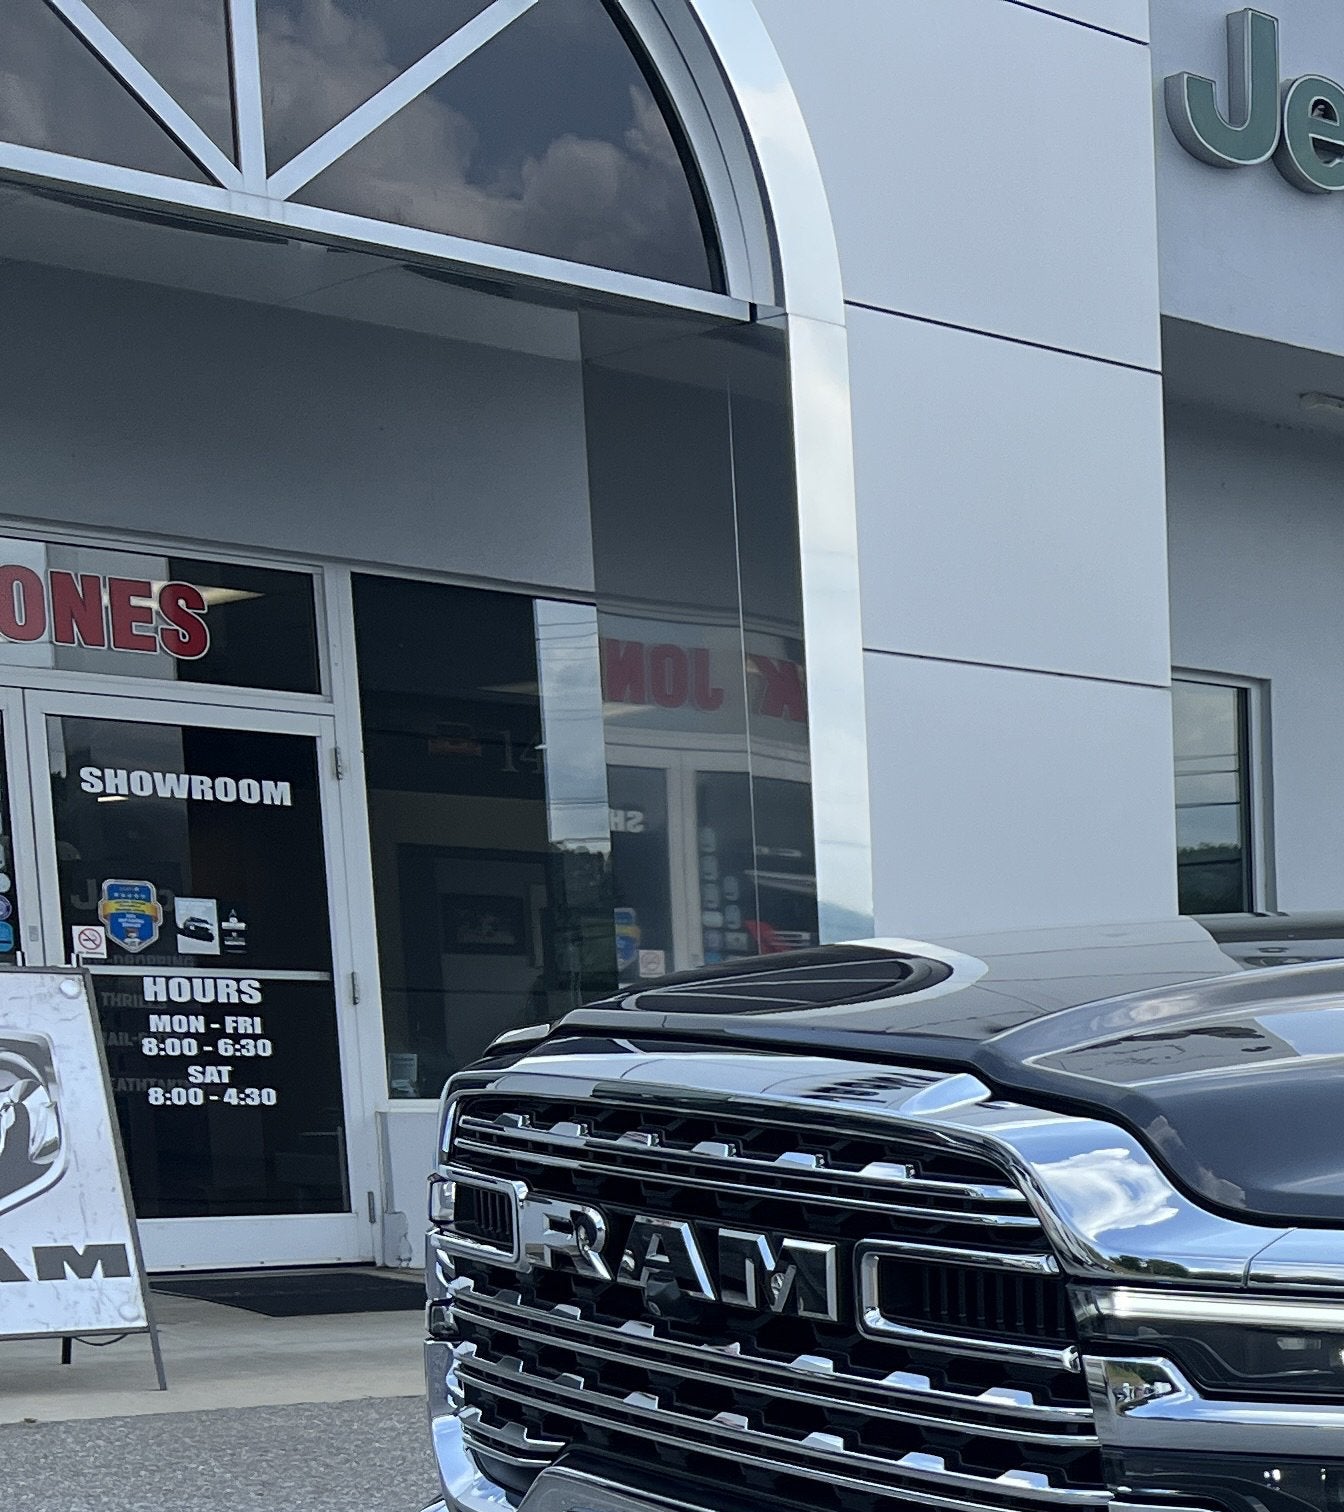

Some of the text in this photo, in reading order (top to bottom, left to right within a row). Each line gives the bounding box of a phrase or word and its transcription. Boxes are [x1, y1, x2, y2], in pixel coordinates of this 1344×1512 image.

[0, 564, 210, 660] ONES
[79, 766, 292, 806] SHOWROOM
[143, 976, 262, 1004] HOURS
[149, 1015, 205, 1034] MON
[225, 1016, 262, 1035] FRI
[142, 1037, 199, 1057] 8:00
[217, 1038, 273, 1057] 6:30
[188, 1065, 234, 1084] SAT
[148, 1087, 204, 1106] 8:00
[223, 1088, 277, 1107] 4:30
[515, 1196, 838, 1323] RAM
